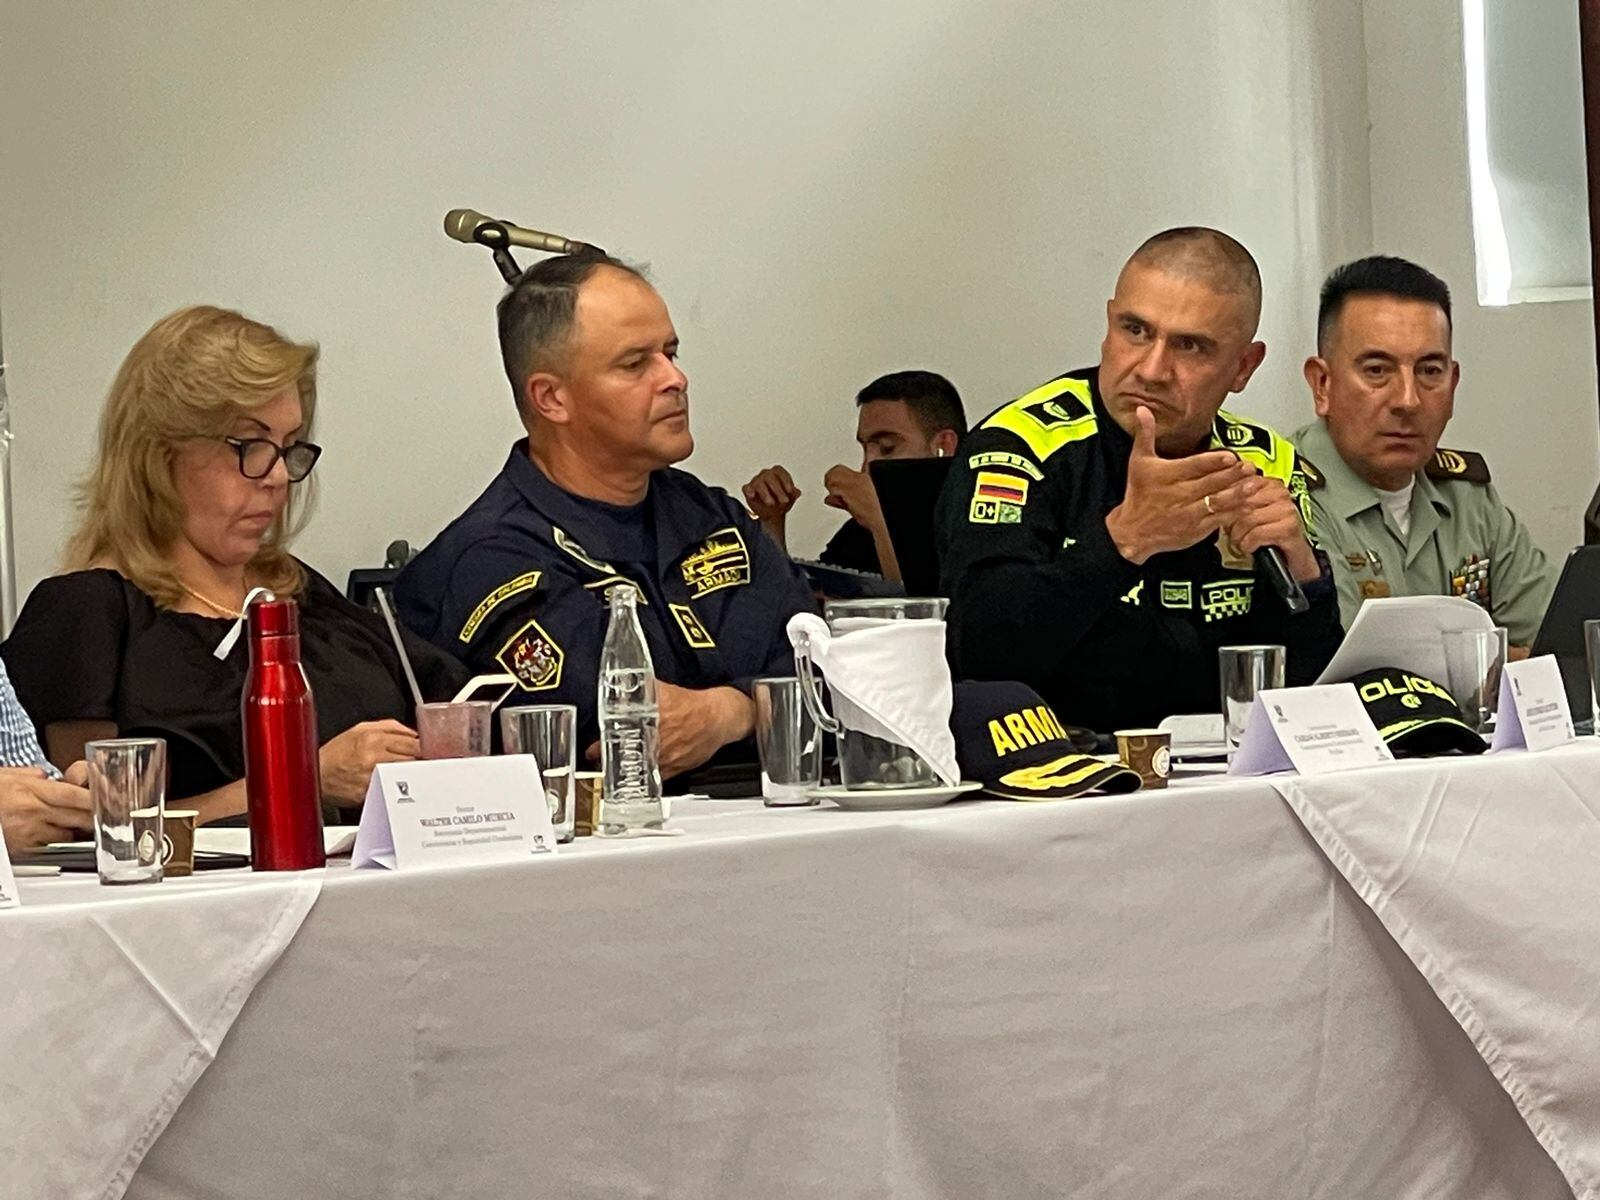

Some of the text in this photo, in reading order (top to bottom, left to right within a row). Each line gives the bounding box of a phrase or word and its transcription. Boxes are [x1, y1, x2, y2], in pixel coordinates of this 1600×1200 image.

[419, 812, 516, 827] WALTER CAMILO MURCIA
